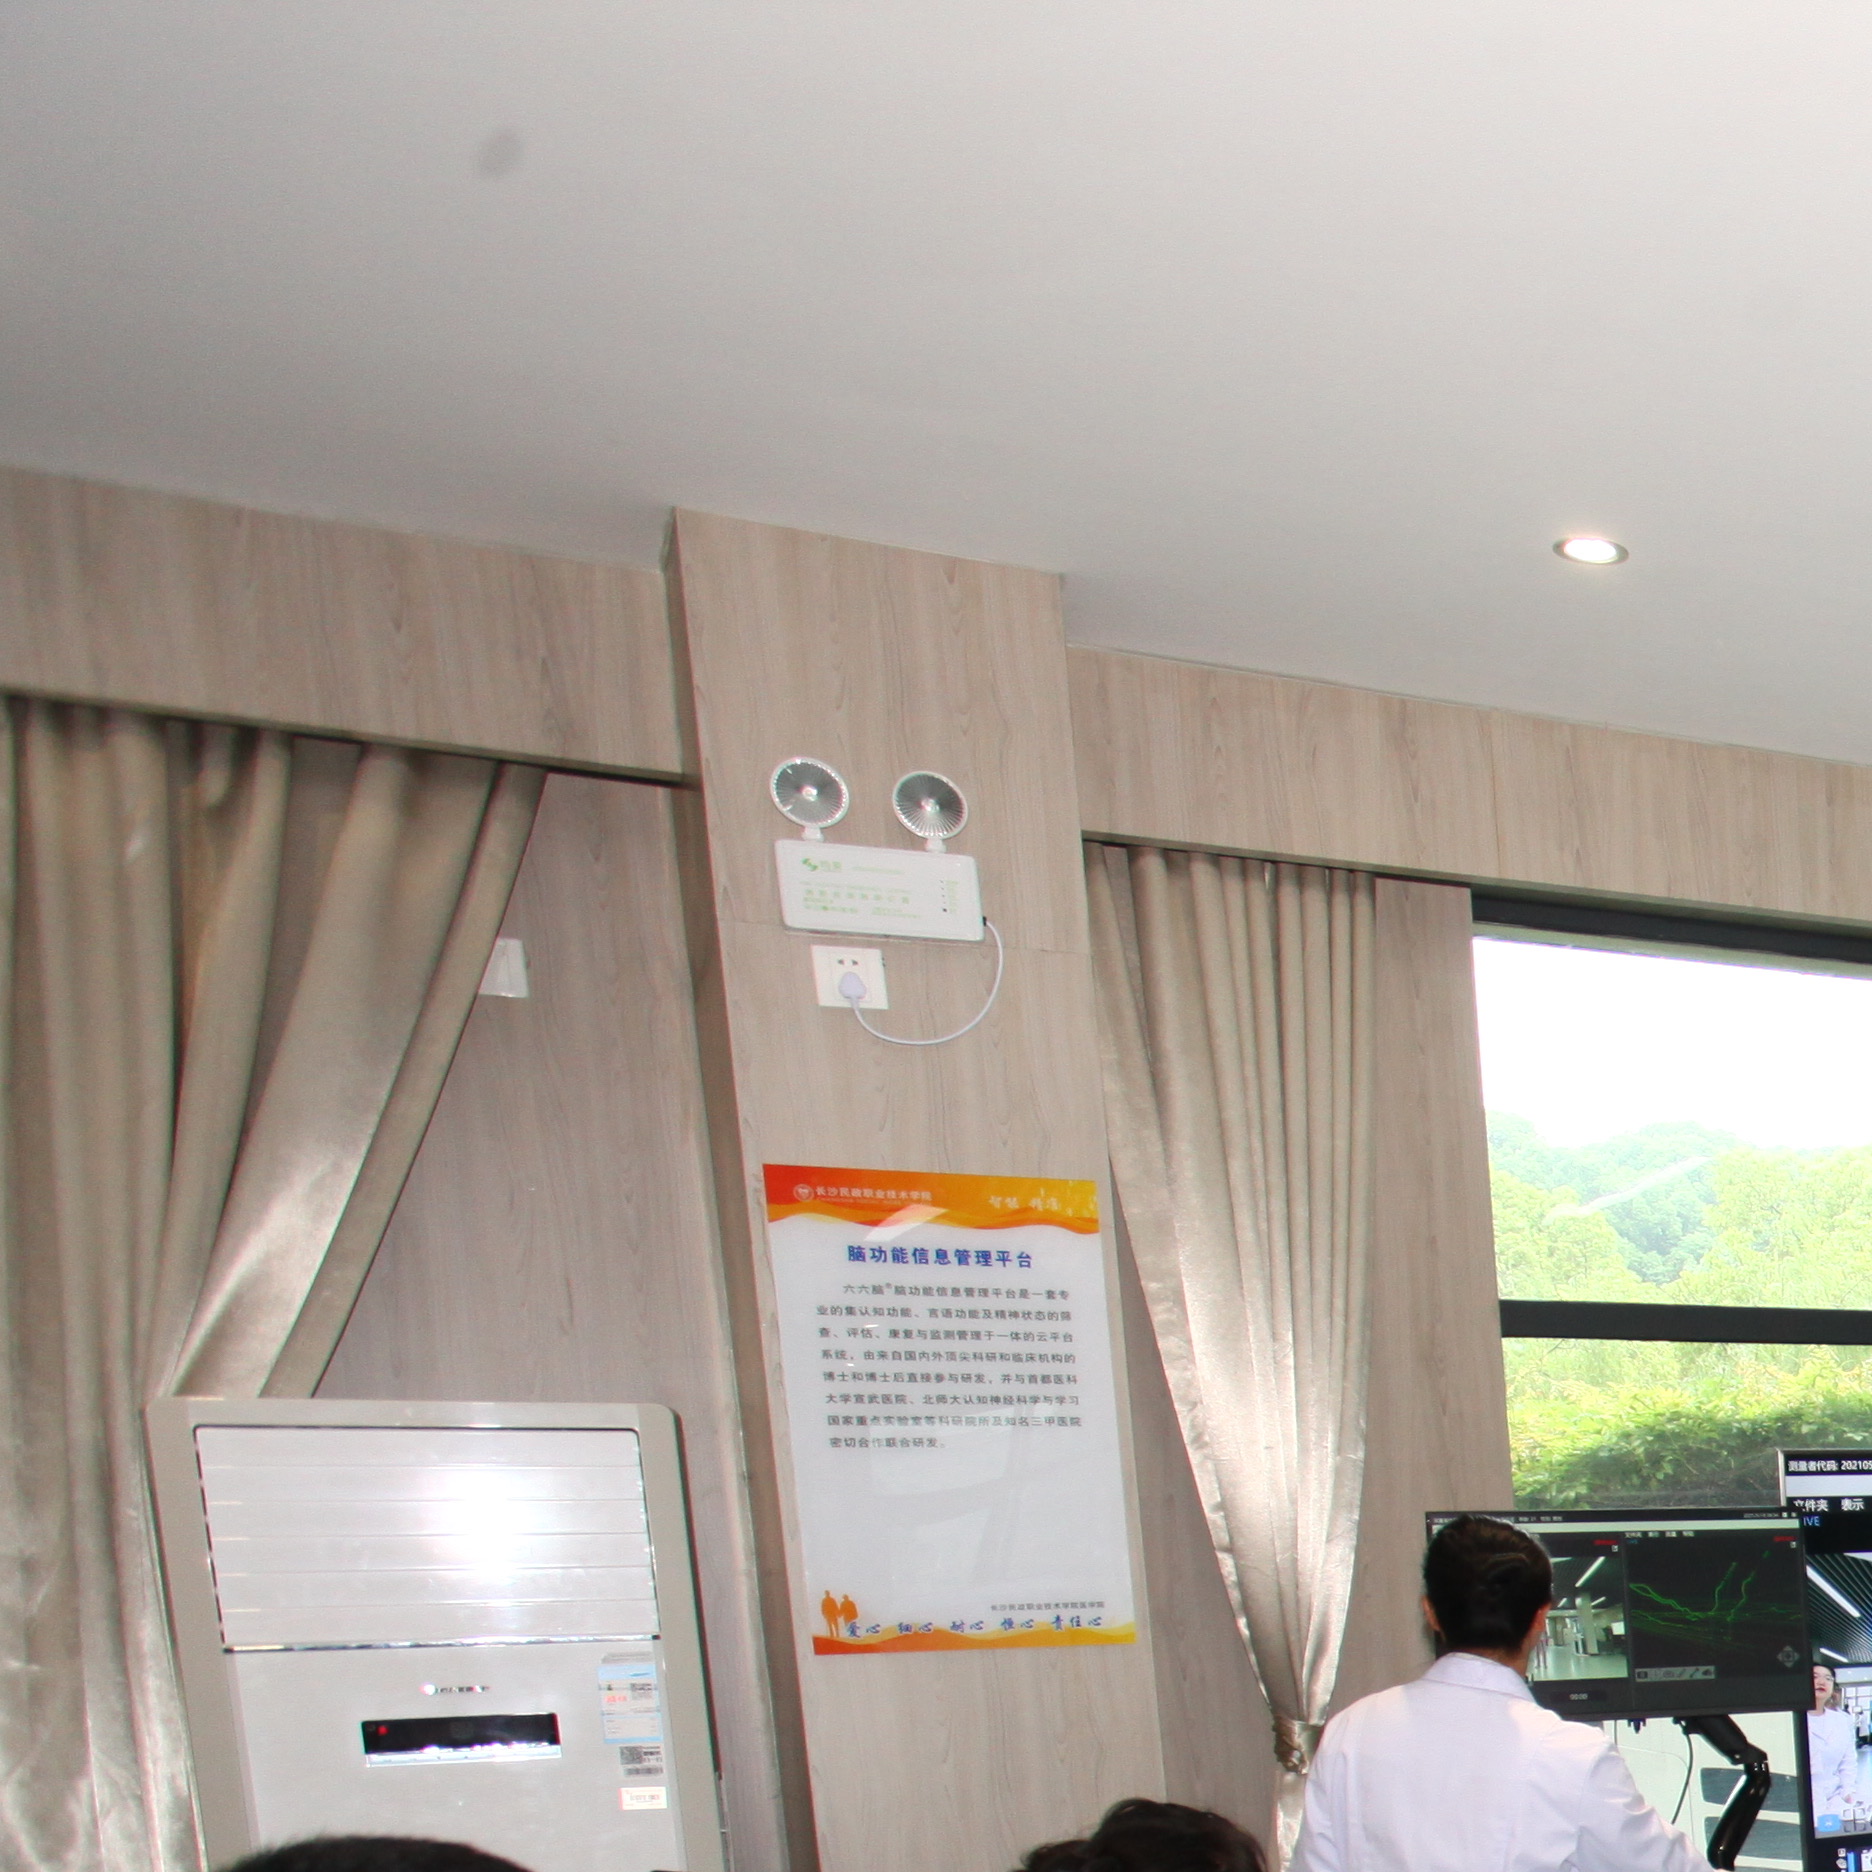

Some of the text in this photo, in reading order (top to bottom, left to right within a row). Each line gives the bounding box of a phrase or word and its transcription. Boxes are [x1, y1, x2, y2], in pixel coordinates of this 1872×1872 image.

[848, 1245, 1032, 1268] 脑功能信息管理平台
[1803, 1516, 1821, 1527] IVE
[846, 1621, 881, 1638] 爱心
[898, 1620, 934, 1634] 细心
